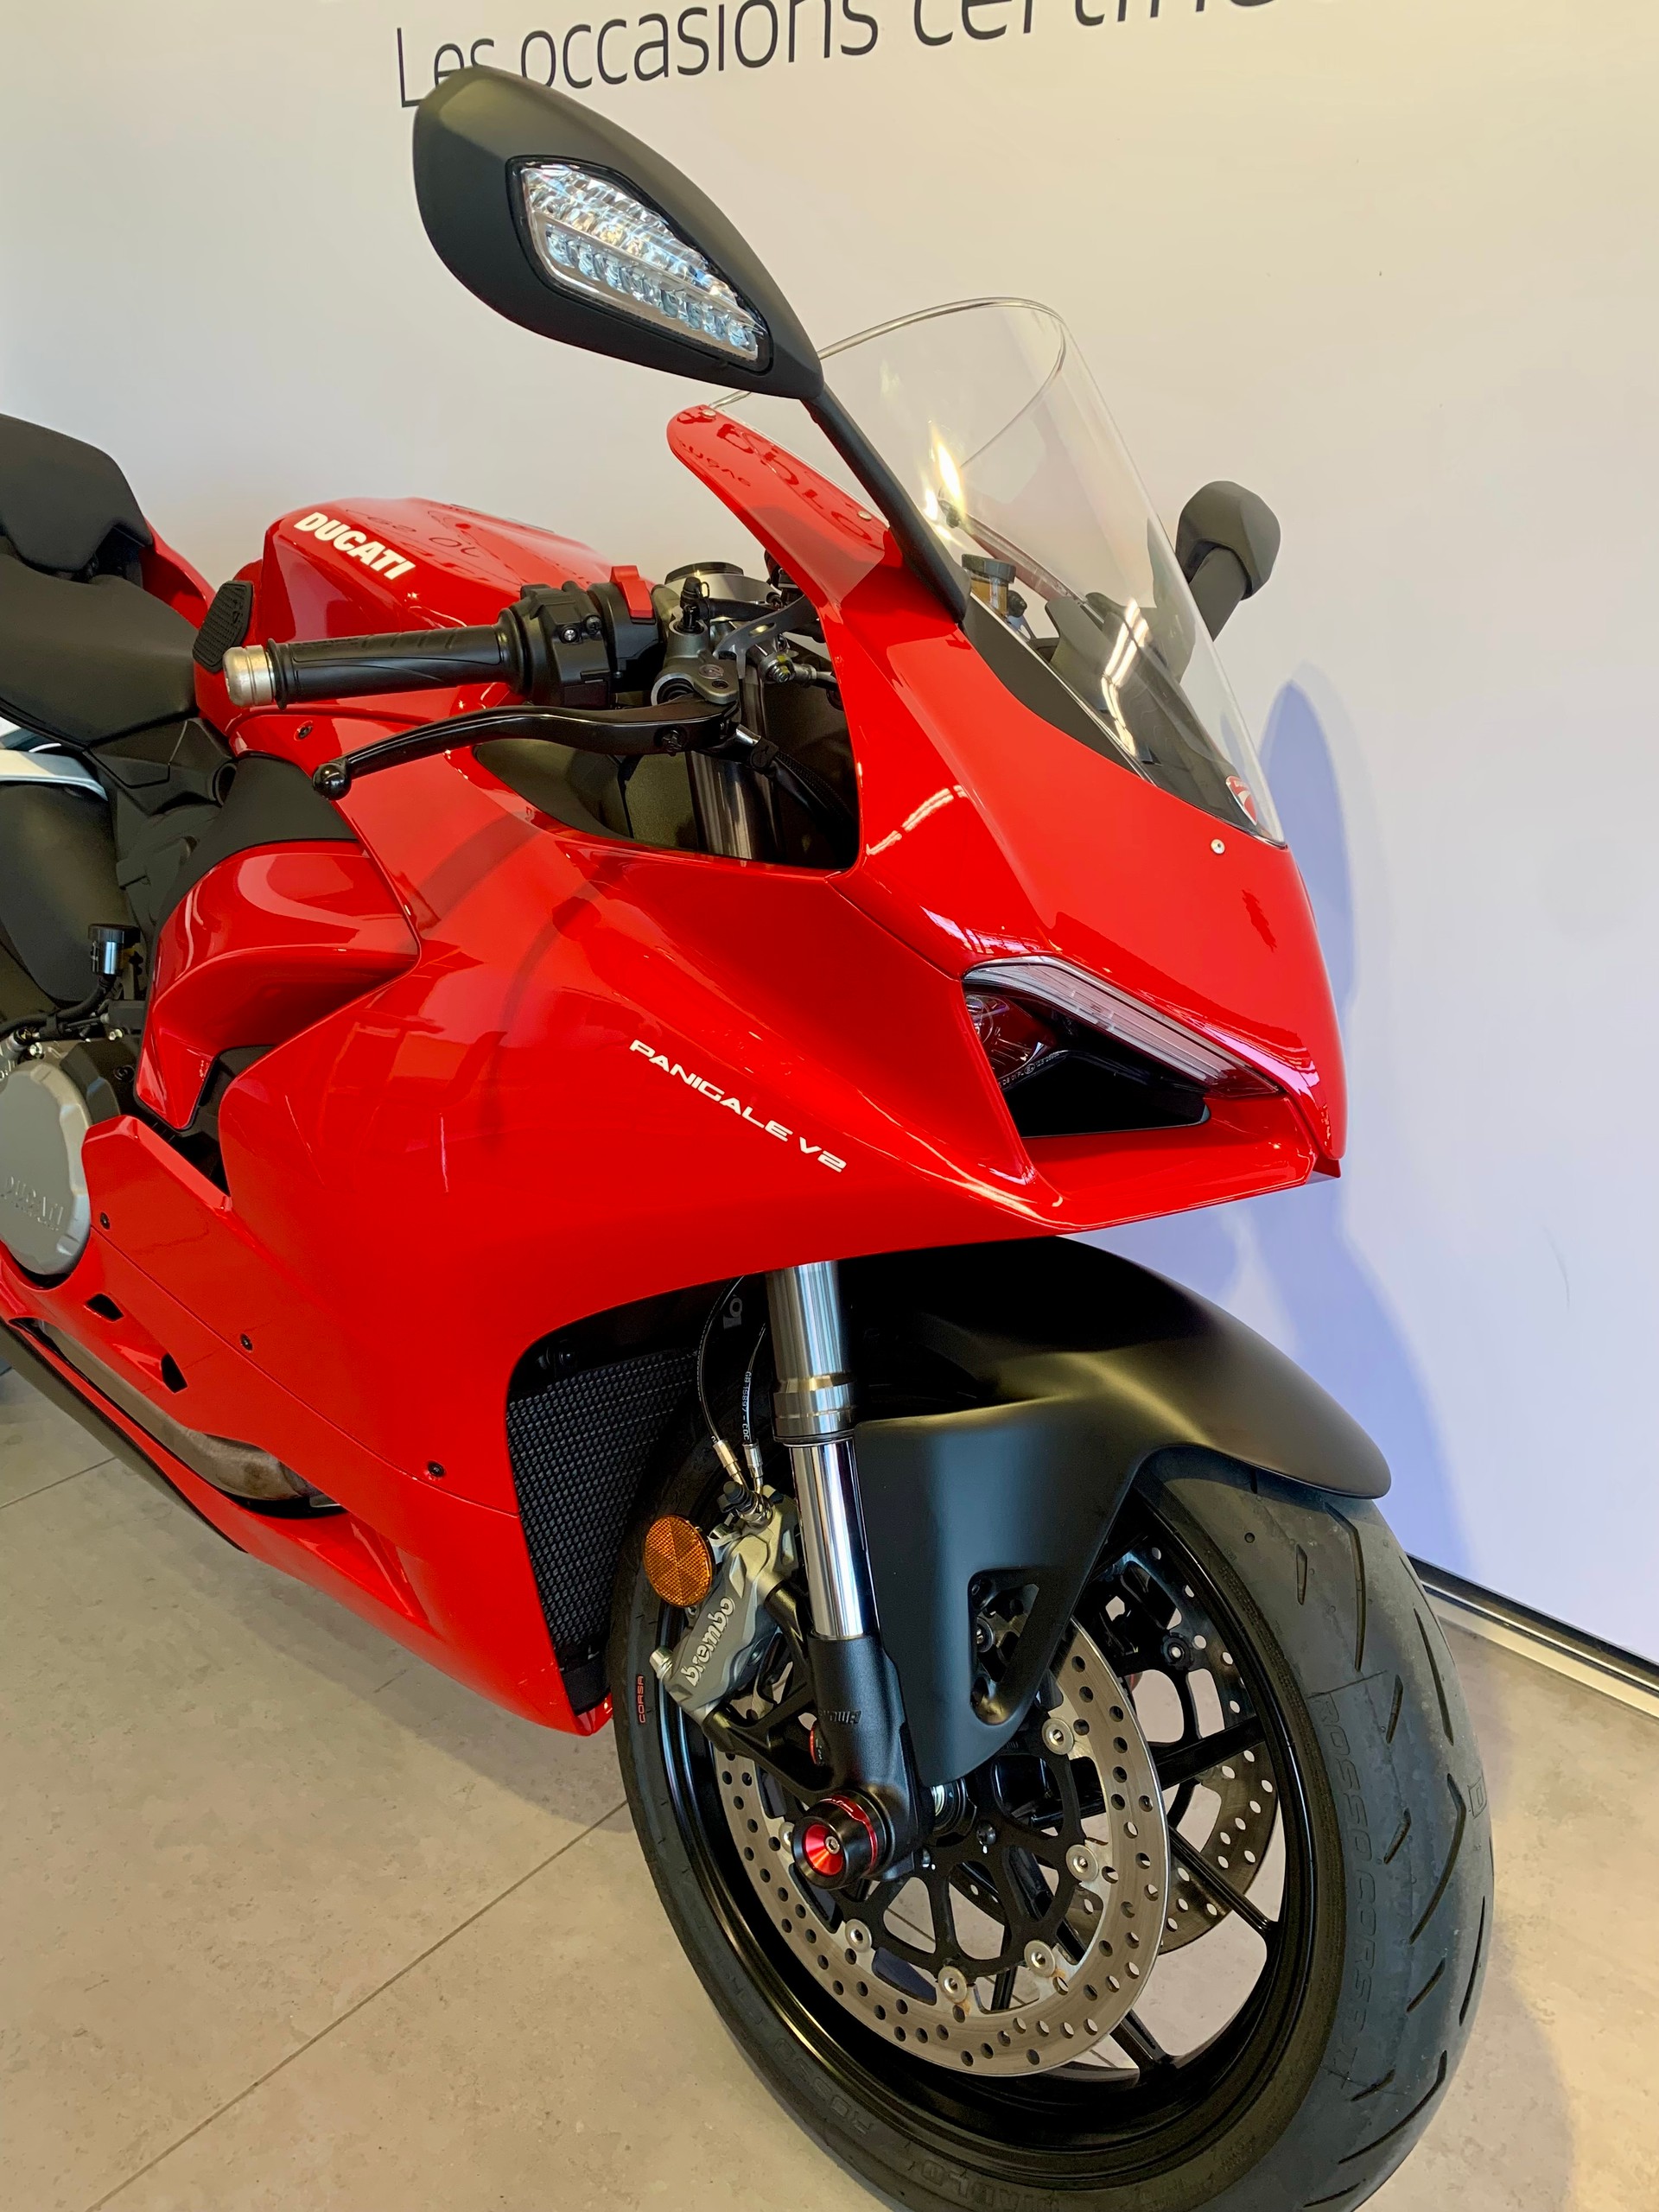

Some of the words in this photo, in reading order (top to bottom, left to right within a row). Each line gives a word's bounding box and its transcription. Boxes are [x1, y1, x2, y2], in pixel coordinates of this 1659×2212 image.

[520, 0, 879, 89] occasions
[293, 512, 416, 580] DUCATI
[629, 1039, 793, 1142] PANIGALE
[799, 1136, 847, 1173] V2
[680, 1597, 735, 1687] brembo
[636, 1675, 646, 1723] CORSA
